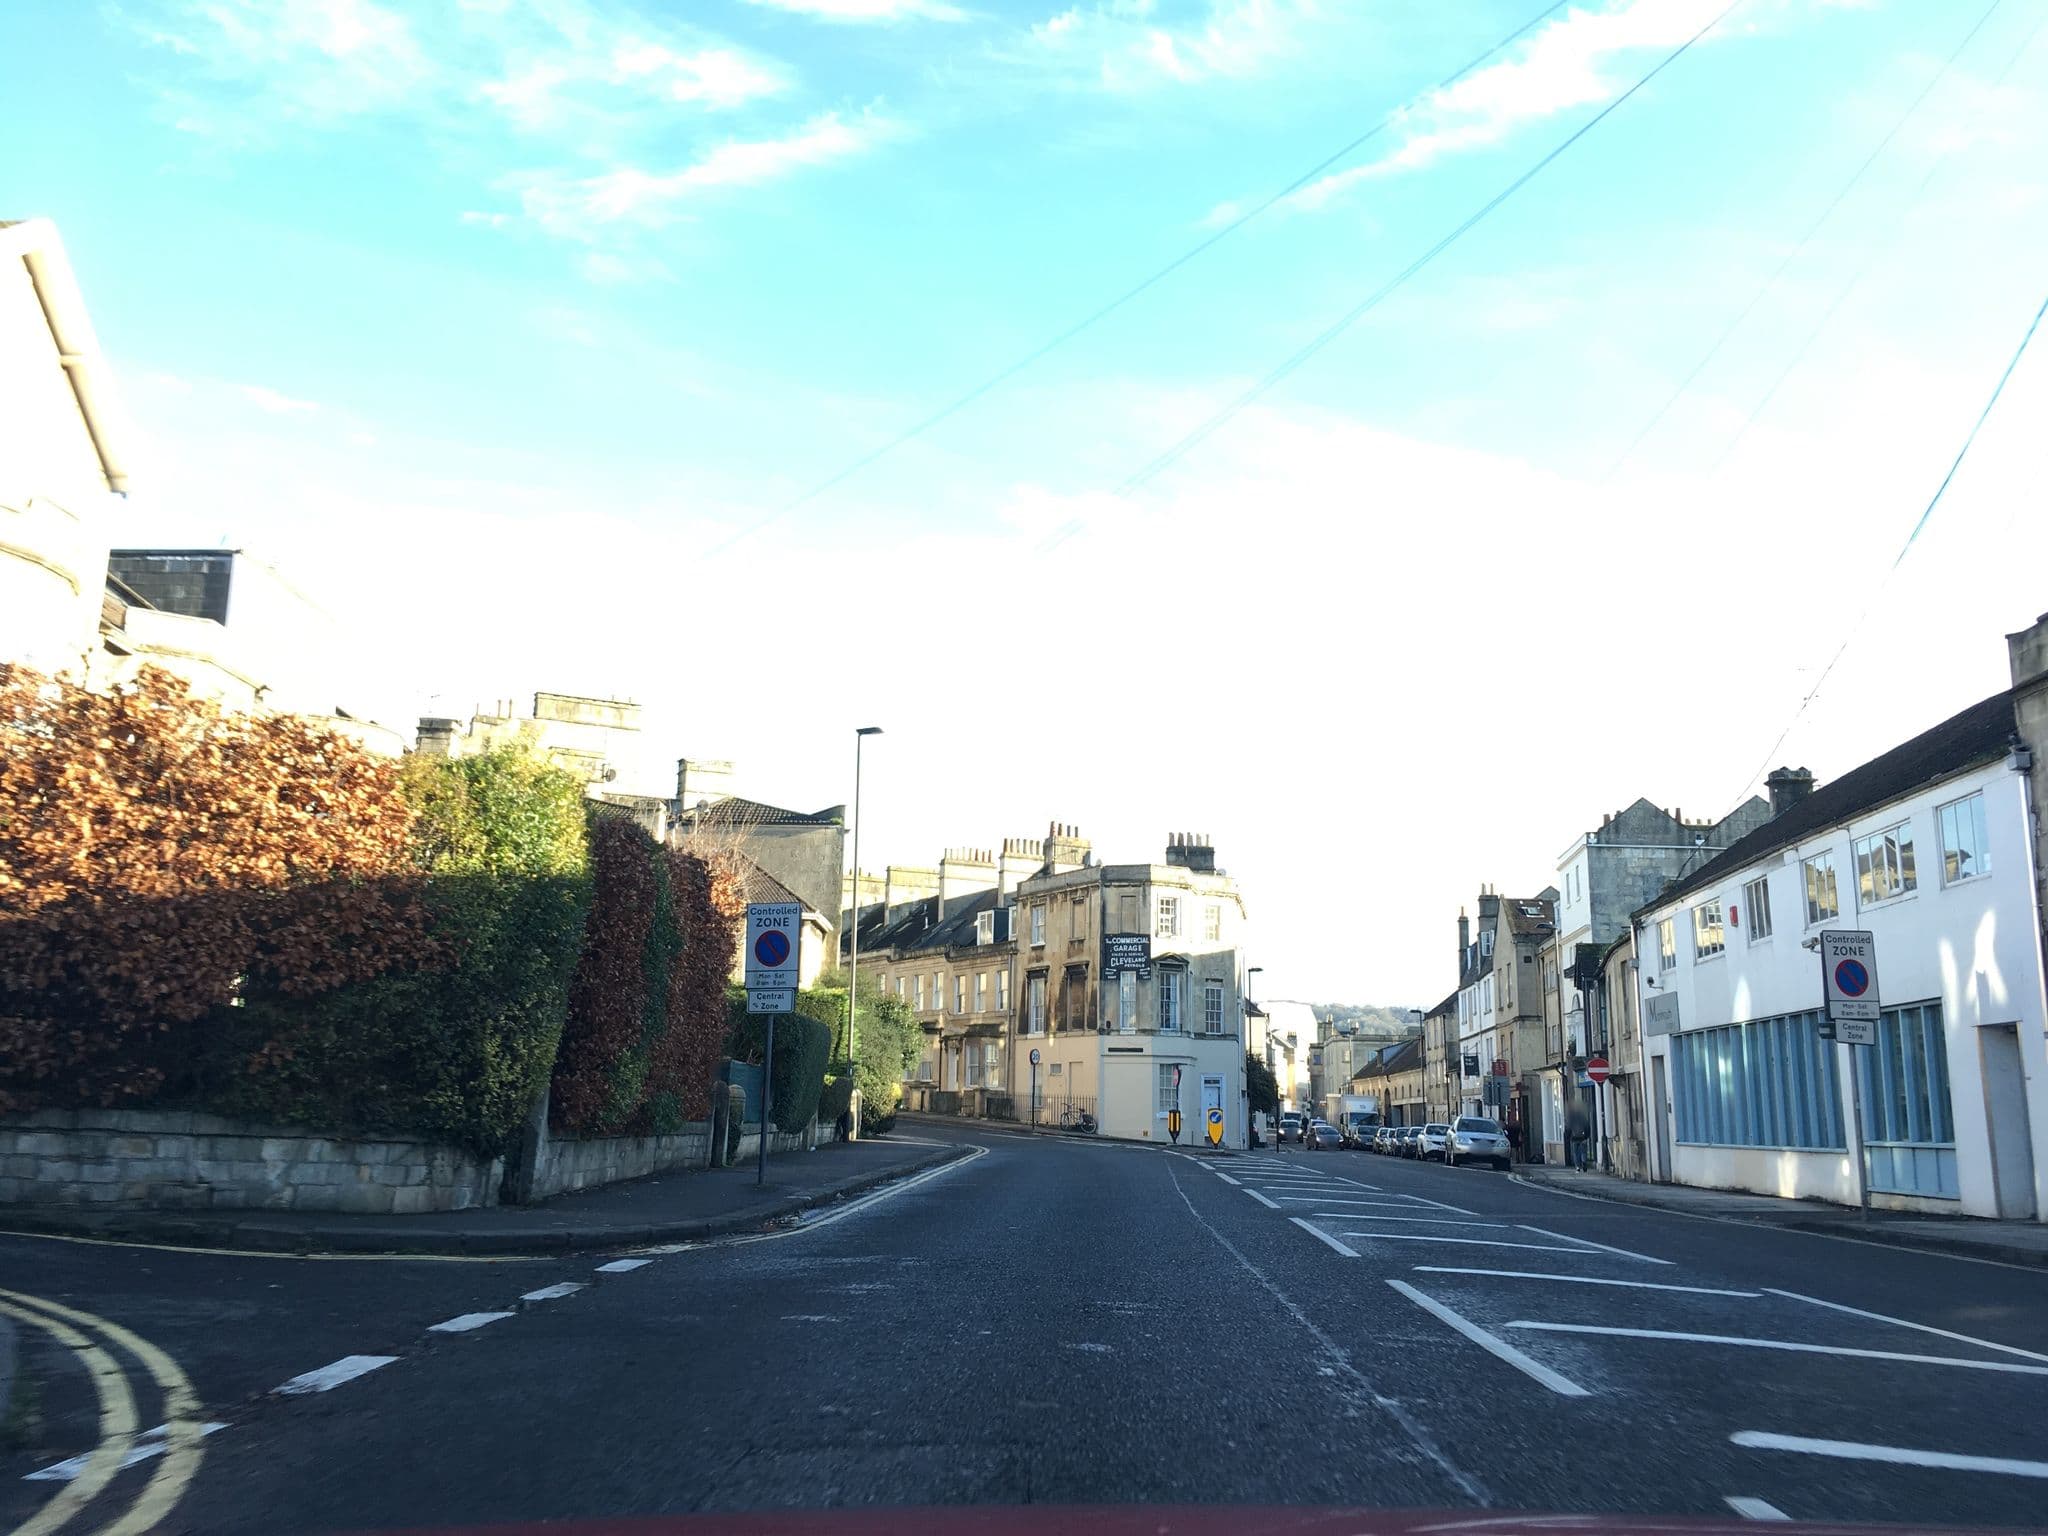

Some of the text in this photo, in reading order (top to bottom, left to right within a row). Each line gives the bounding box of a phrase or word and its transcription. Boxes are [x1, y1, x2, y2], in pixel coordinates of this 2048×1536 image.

[750, 906, 798, 915] Controlled
[756, 917, 789, 927] ZONE
[1825, 934, 1871, 944] Controlled
[1832, 946, 1865, 956] ZONE
[756, 992, 785, 1000] Central
[760, 1002, 779, 1010] Zone
[1842, 1023, 1868, 1031] Central
[1847, 1032, 1863, 1040] Zone
